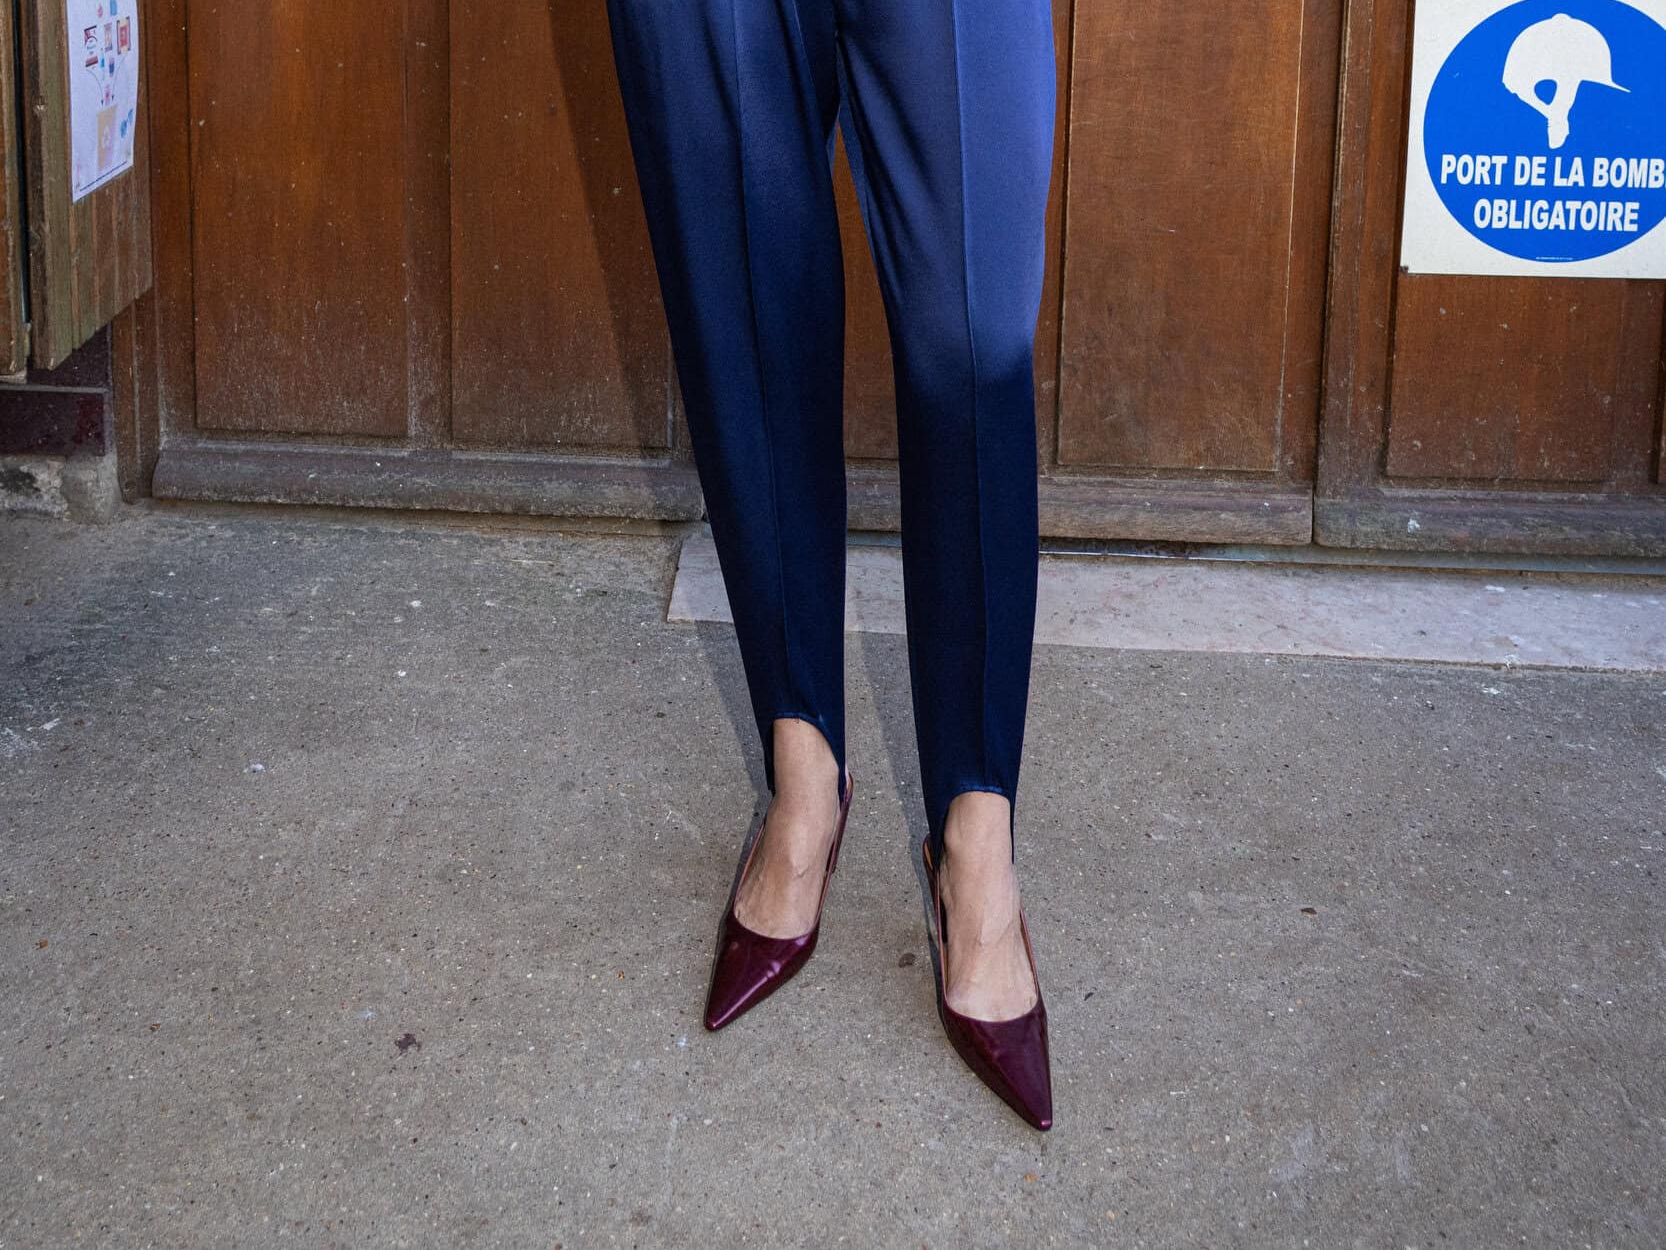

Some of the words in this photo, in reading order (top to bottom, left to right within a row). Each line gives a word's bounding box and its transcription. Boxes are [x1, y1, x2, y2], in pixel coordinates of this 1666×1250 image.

[1440, 154, 1508, 186] PORT
[1513, 155, 1548, 187] DE
[1552, 156, 1586, 188] LA
[1591, 157, 1666, 189] BOMB
[1472, 198, 1641, 233] OBLIGATOIRE
